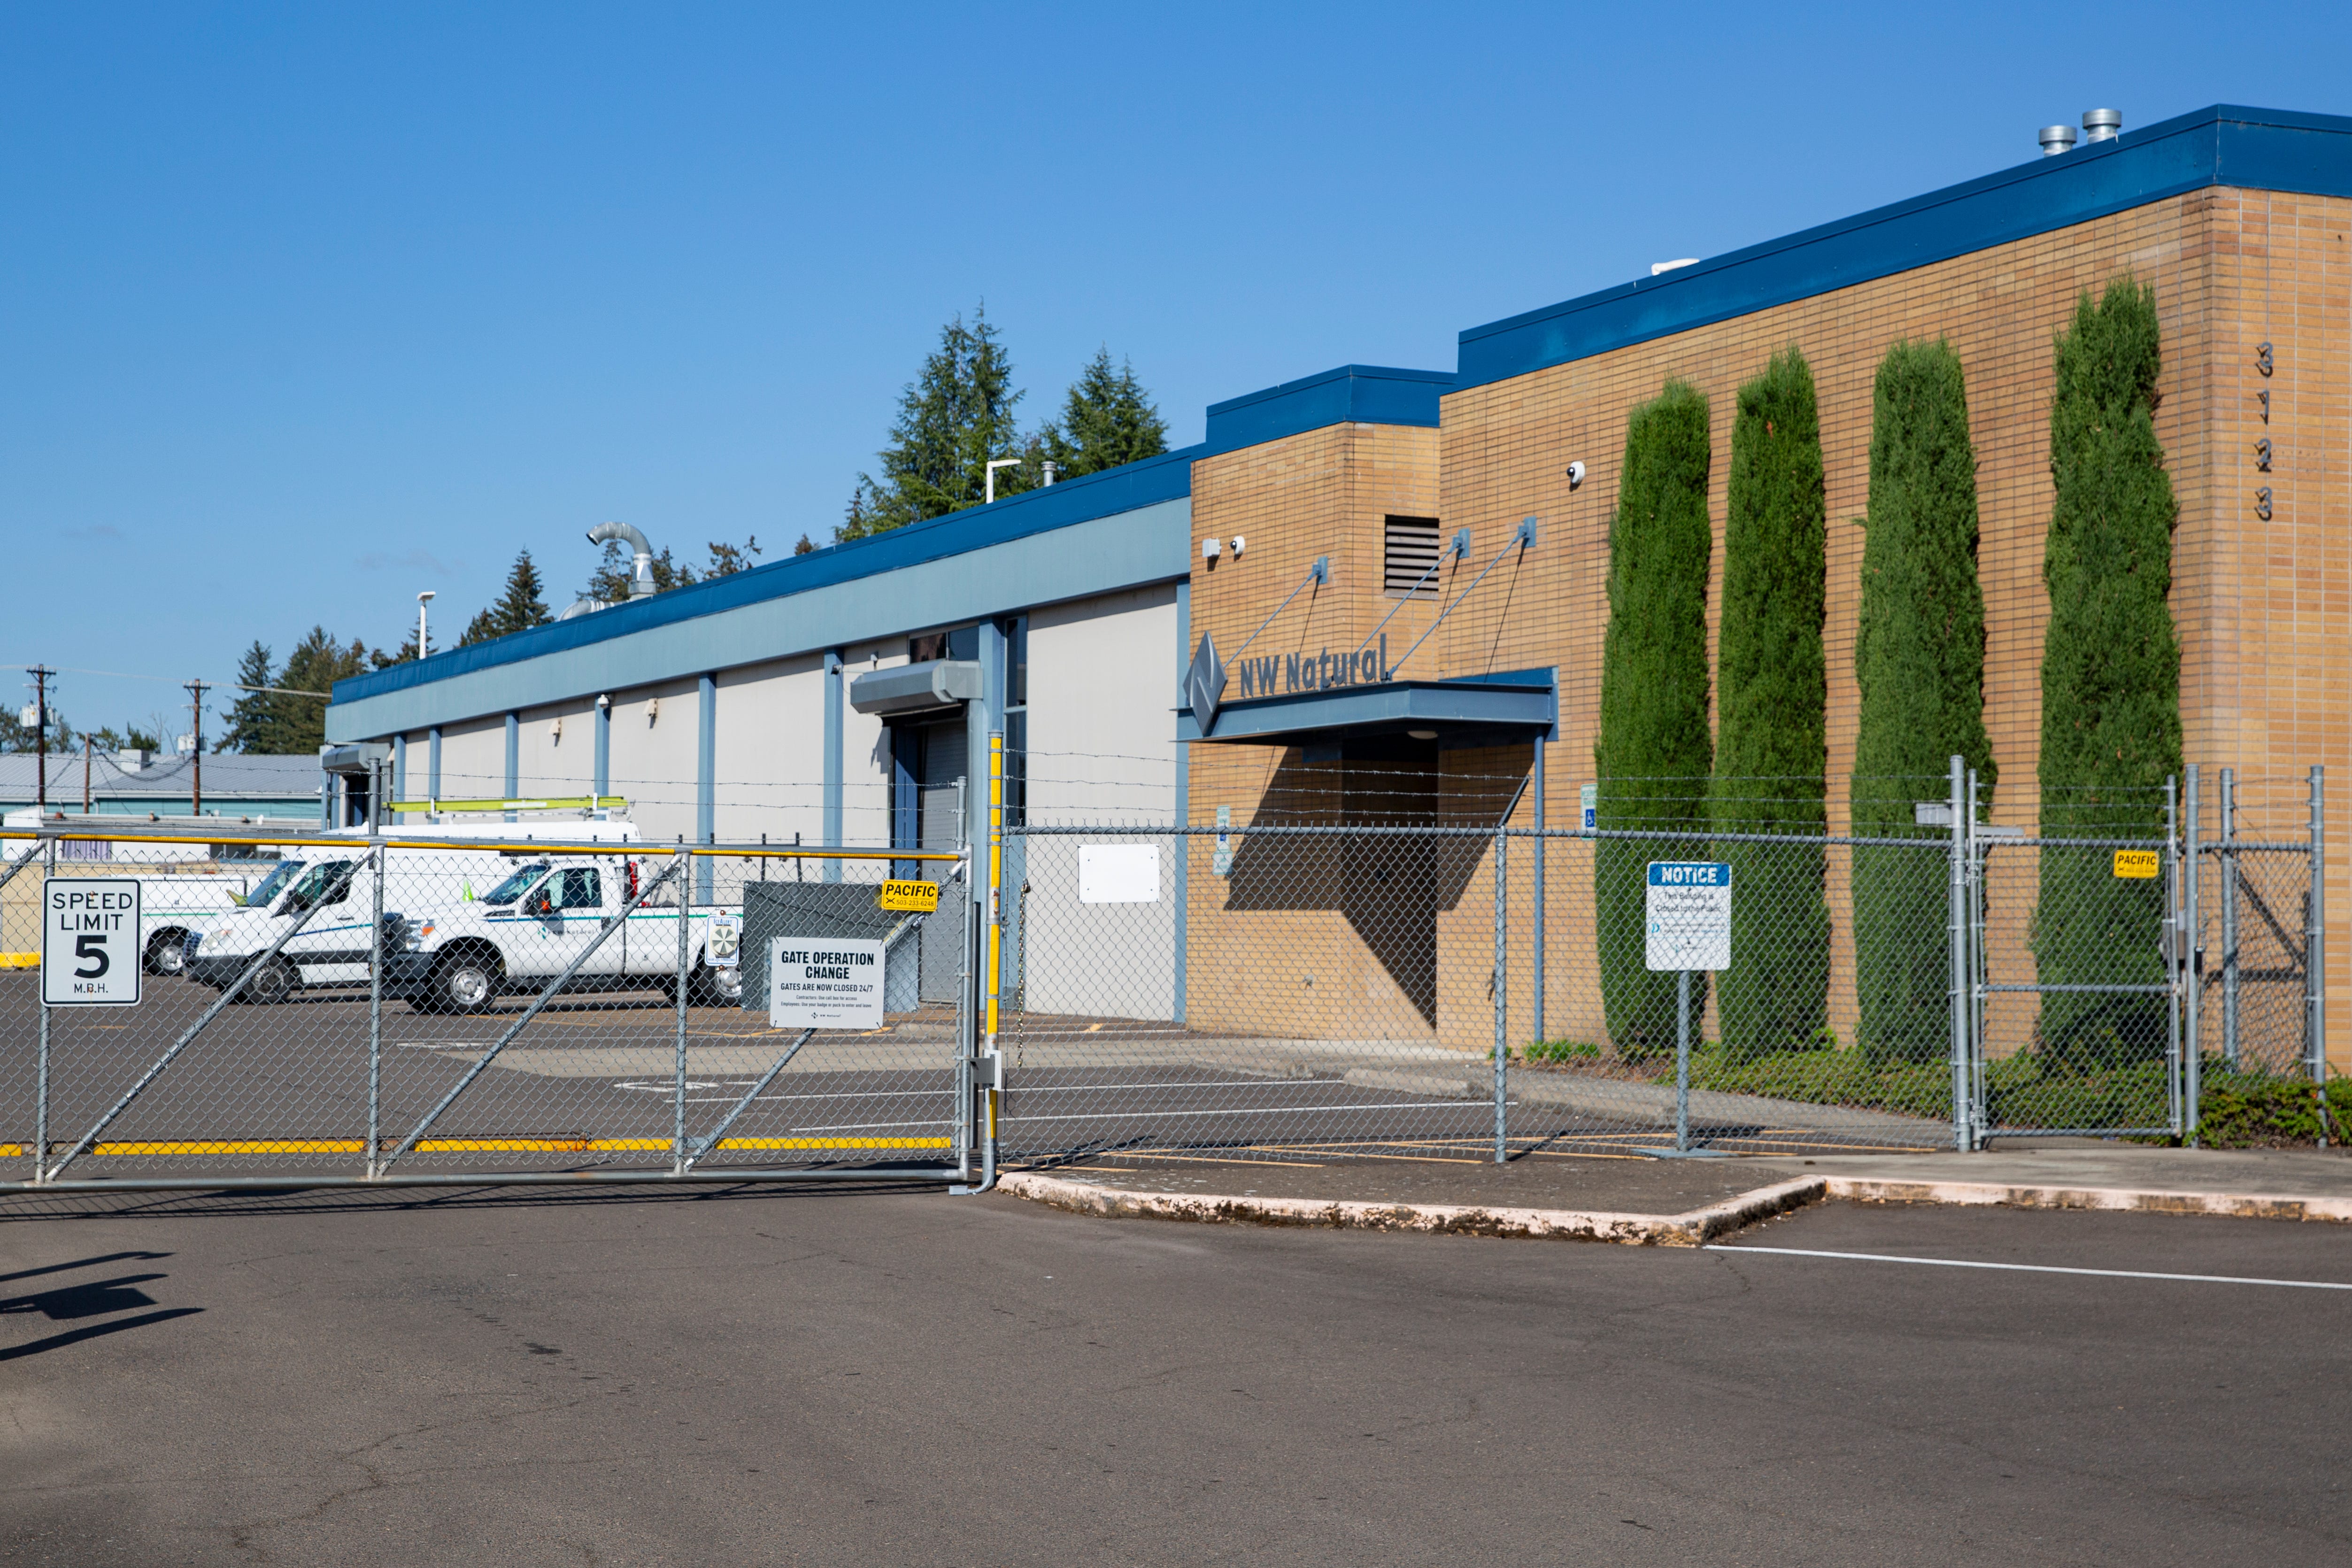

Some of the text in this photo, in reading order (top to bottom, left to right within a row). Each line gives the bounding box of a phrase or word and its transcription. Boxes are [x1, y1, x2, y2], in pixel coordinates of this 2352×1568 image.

[1241, 633, 1387, 697] NW Natural
[2118, 855, 2156, 865] PACIFIC
[1661, 866, 1717, 883] NOTICE
[886, 884, 935, 897] PACIFIC
[52, 893, 132, 909] SPEED
[61, 914, 123, 930] LIMIT
[74, 935, 109, 979] 5
[781, 951, 874, 965] GATE OPERATION
[805, 966, 849, 979] CHANGE
